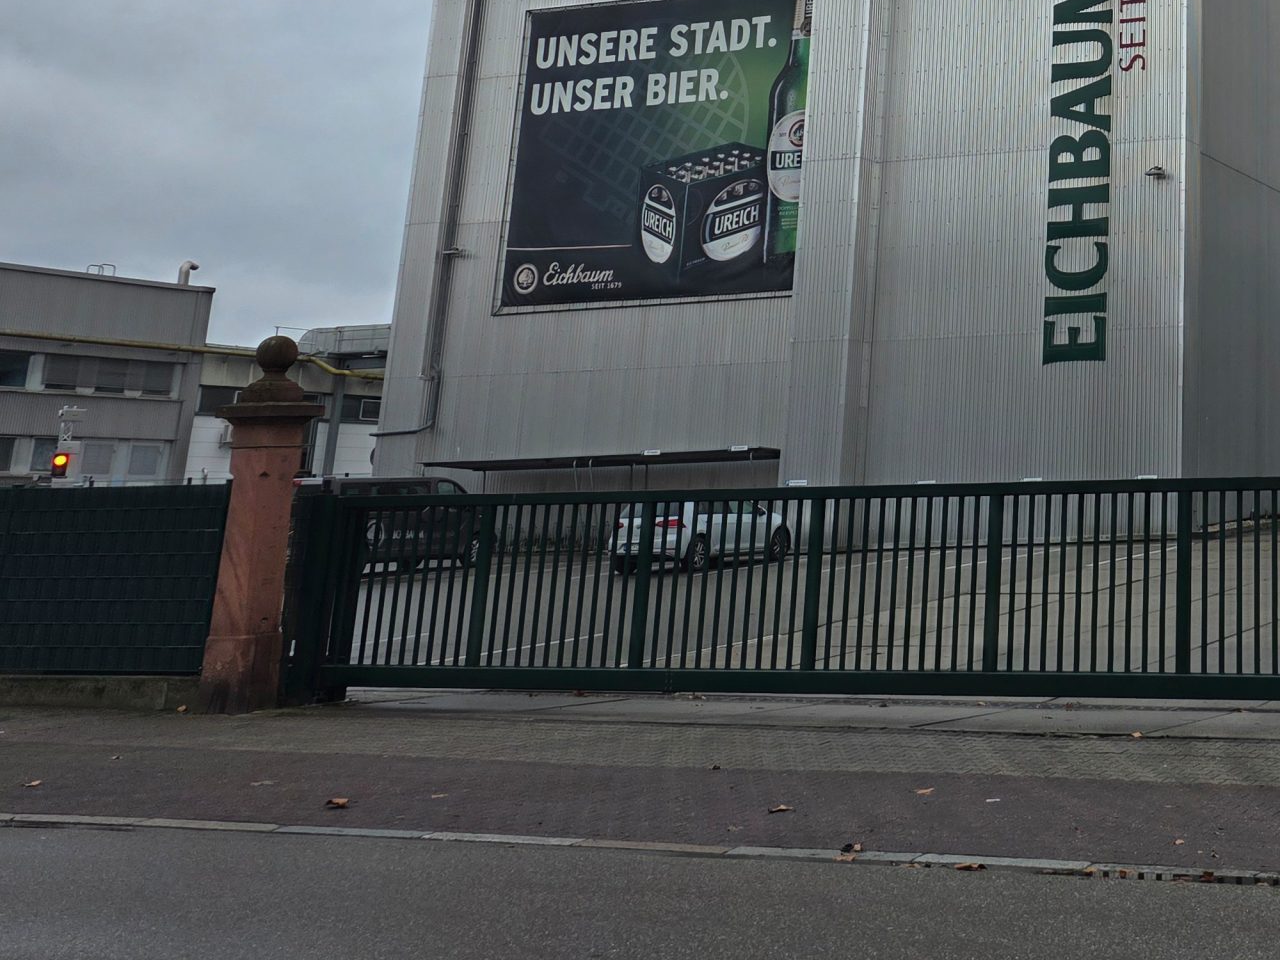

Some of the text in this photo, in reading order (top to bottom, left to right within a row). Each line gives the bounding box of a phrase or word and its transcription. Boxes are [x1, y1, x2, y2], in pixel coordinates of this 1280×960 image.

[535, 15, 778, 70] UNSERE STADT.
[530, 68, 729, 116] UNSER BIER.
[776, 152, 802, 169] URE
[644, 209, 674, 239] UREICH
[714, 204, 760, 235] UREICH
[543, 262, 615, 286] Eichbaum
[591, 281, 622, 290] SEIT 1679
